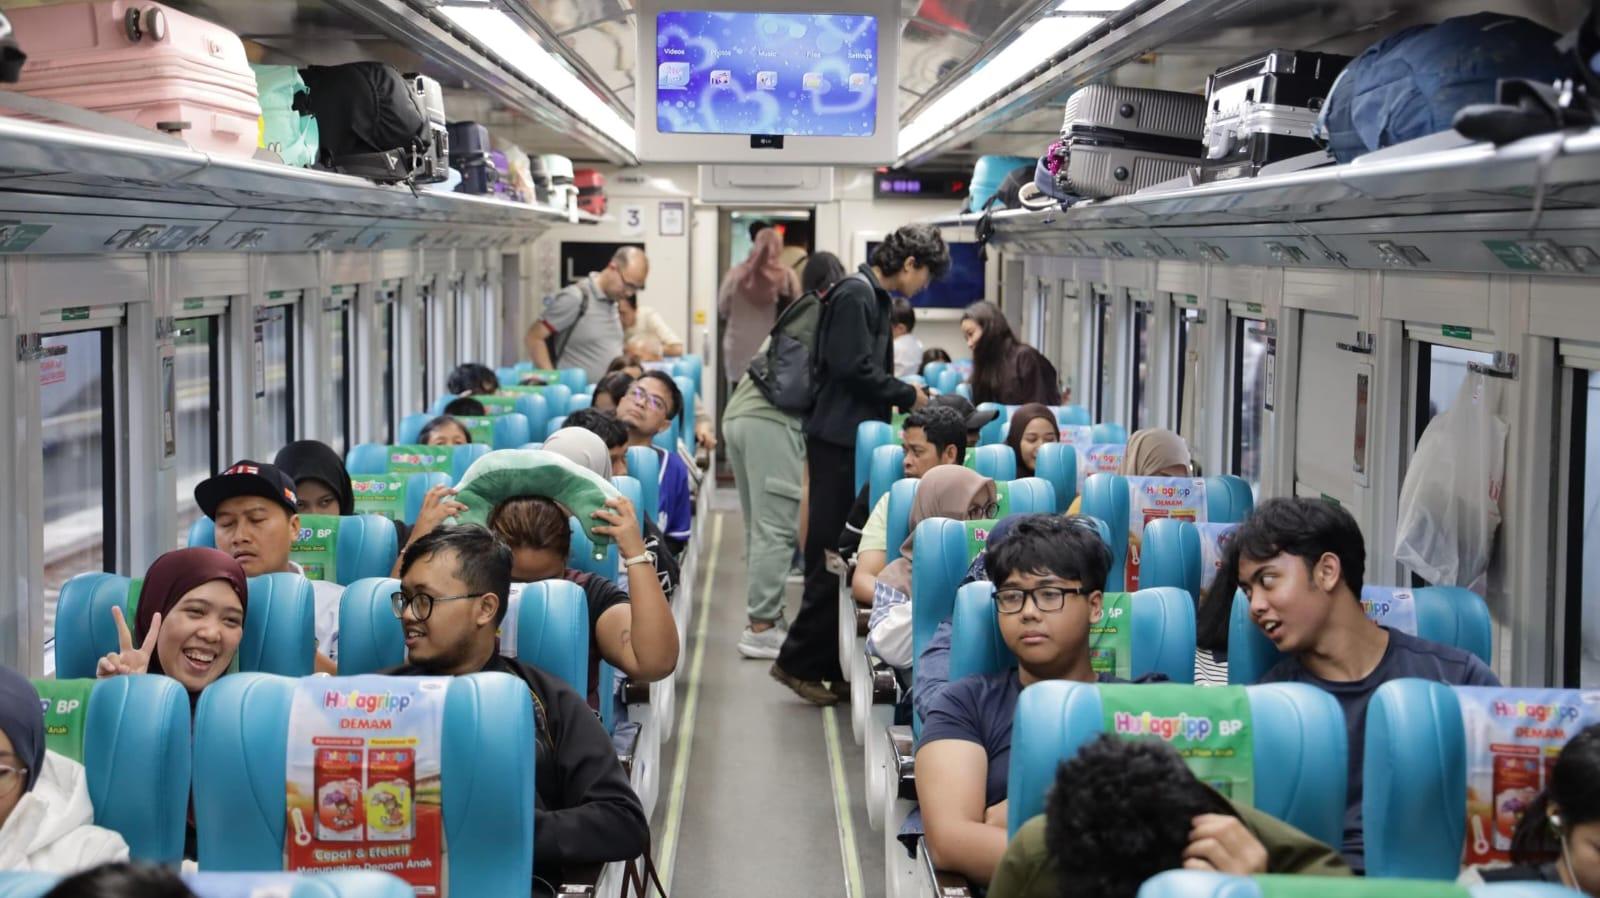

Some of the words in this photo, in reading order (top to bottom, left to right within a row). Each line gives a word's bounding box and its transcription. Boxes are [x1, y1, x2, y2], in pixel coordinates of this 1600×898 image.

[663, 48, 686, 56] Videos
[848, 53, 873, 61] Settings
[627, 209, 640, 227] 3
[56, 699, 80, 714] BP
[325, 690, 411, 713] Hufagripp
[1494, 700, 1579, 722] Hufagripp
[340, 718, 393, 730] DEMAM
[1114, 711, 1212, 741] Hufagripp
[1219, 719, 1243, 736] BP
[313, 849, 352, 863] Cepat
[355, 848, 366, 859] &
[368, 844, 411, 859] Efektif
[406, 857, 433, 869] Anak
